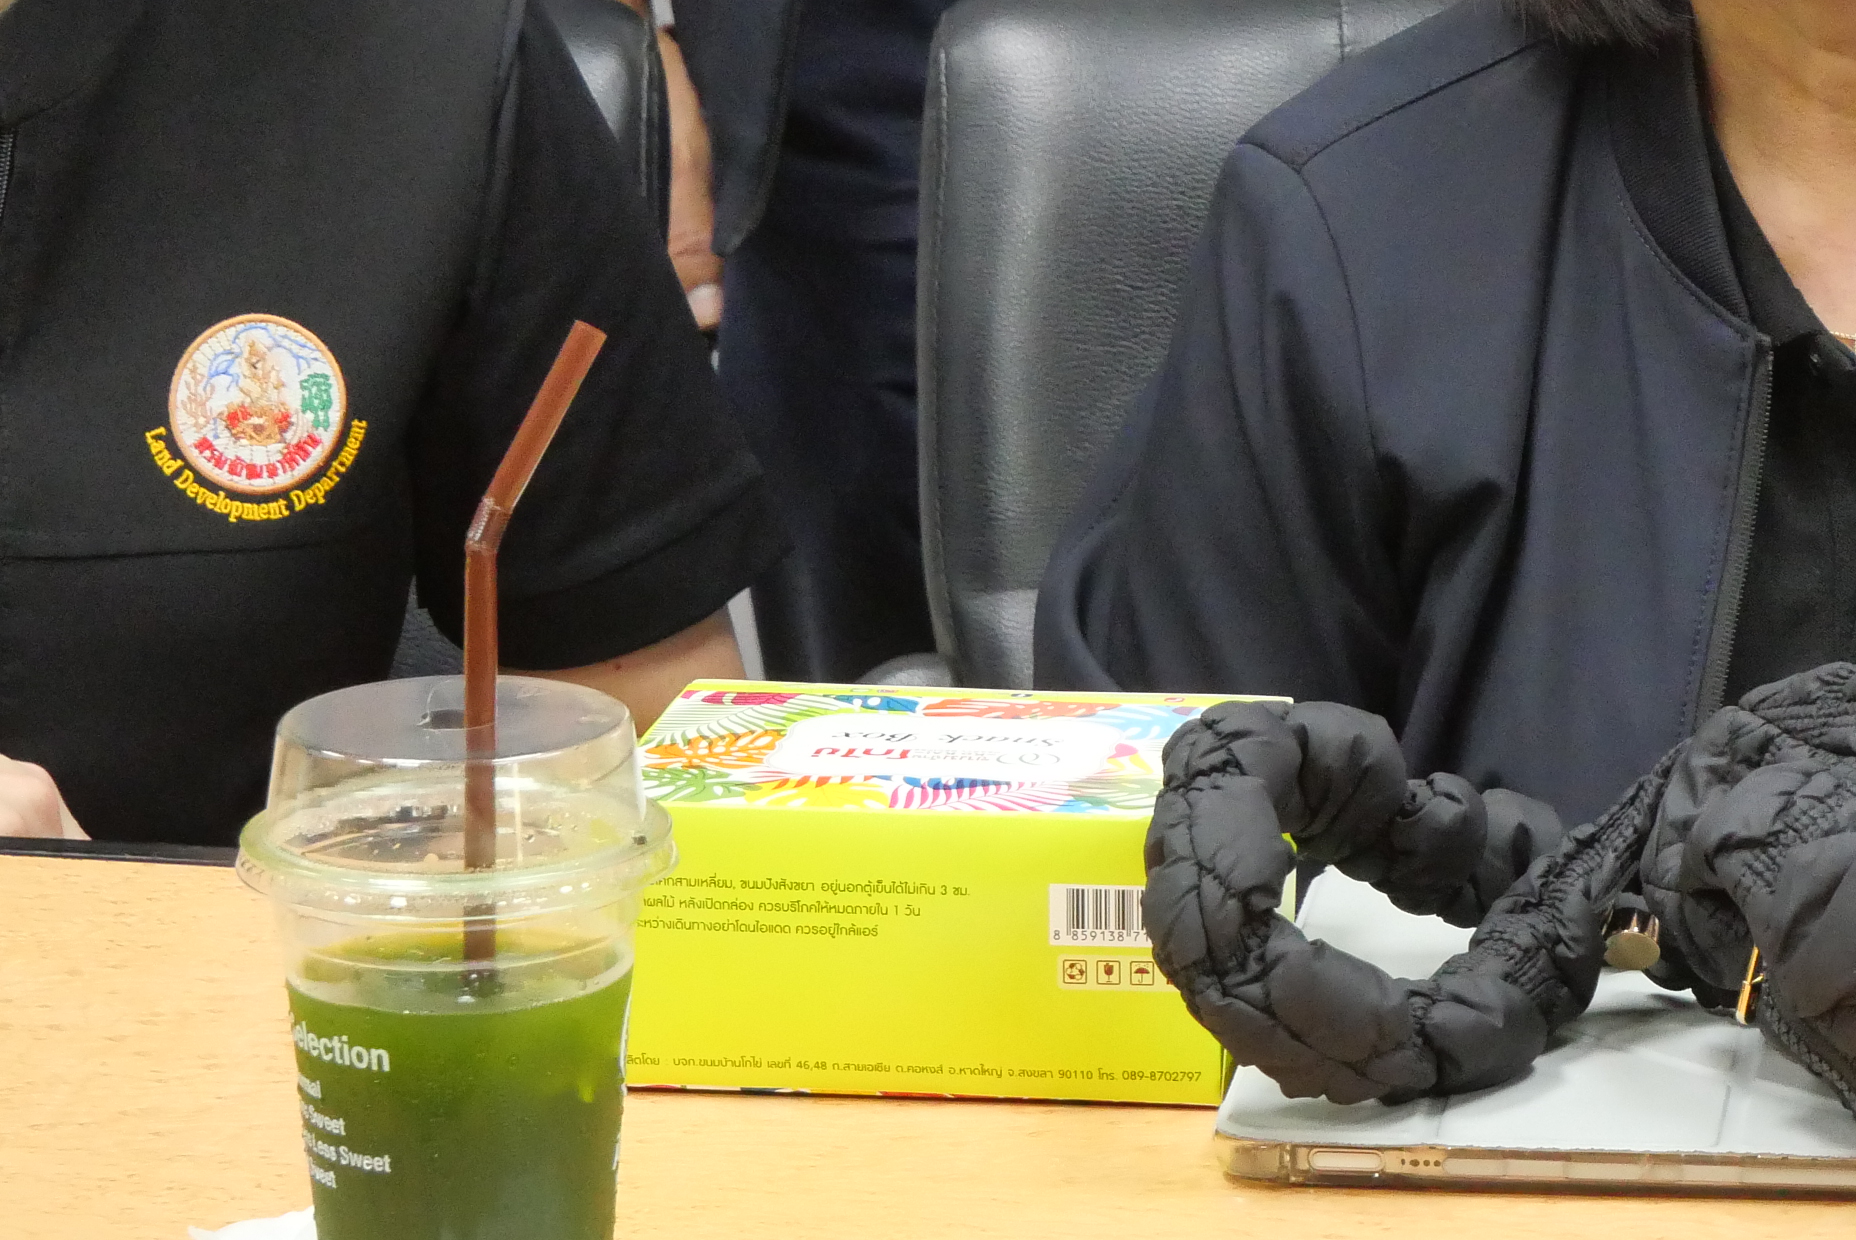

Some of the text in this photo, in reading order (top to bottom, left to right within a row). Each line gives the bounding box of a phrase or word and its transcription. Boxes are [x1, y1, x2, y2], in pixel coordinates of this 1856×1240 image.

[145, 418, 369, 523] Land Development Department
[831, 731, 1065, 748] Snack Box
[940, 884, 948, 896] 3
[952, 885, 971, 897] ชม.
[904, 904, 921, 917] วัน
[1053, 929, 1061, 941] 8
[1070, 930, 1126, 942] 859138
[289, 1010, 391, 1073] election
[626, 1052, 661, 1066] ลิตโดย
[796, 1061, 828, 1072] 46,48
[1058, 1069, 1094, 1080] 90110
[1121, 1070, 1202, 1082] 089-8702797
[338, 1145, 392, 1174] Sweet
